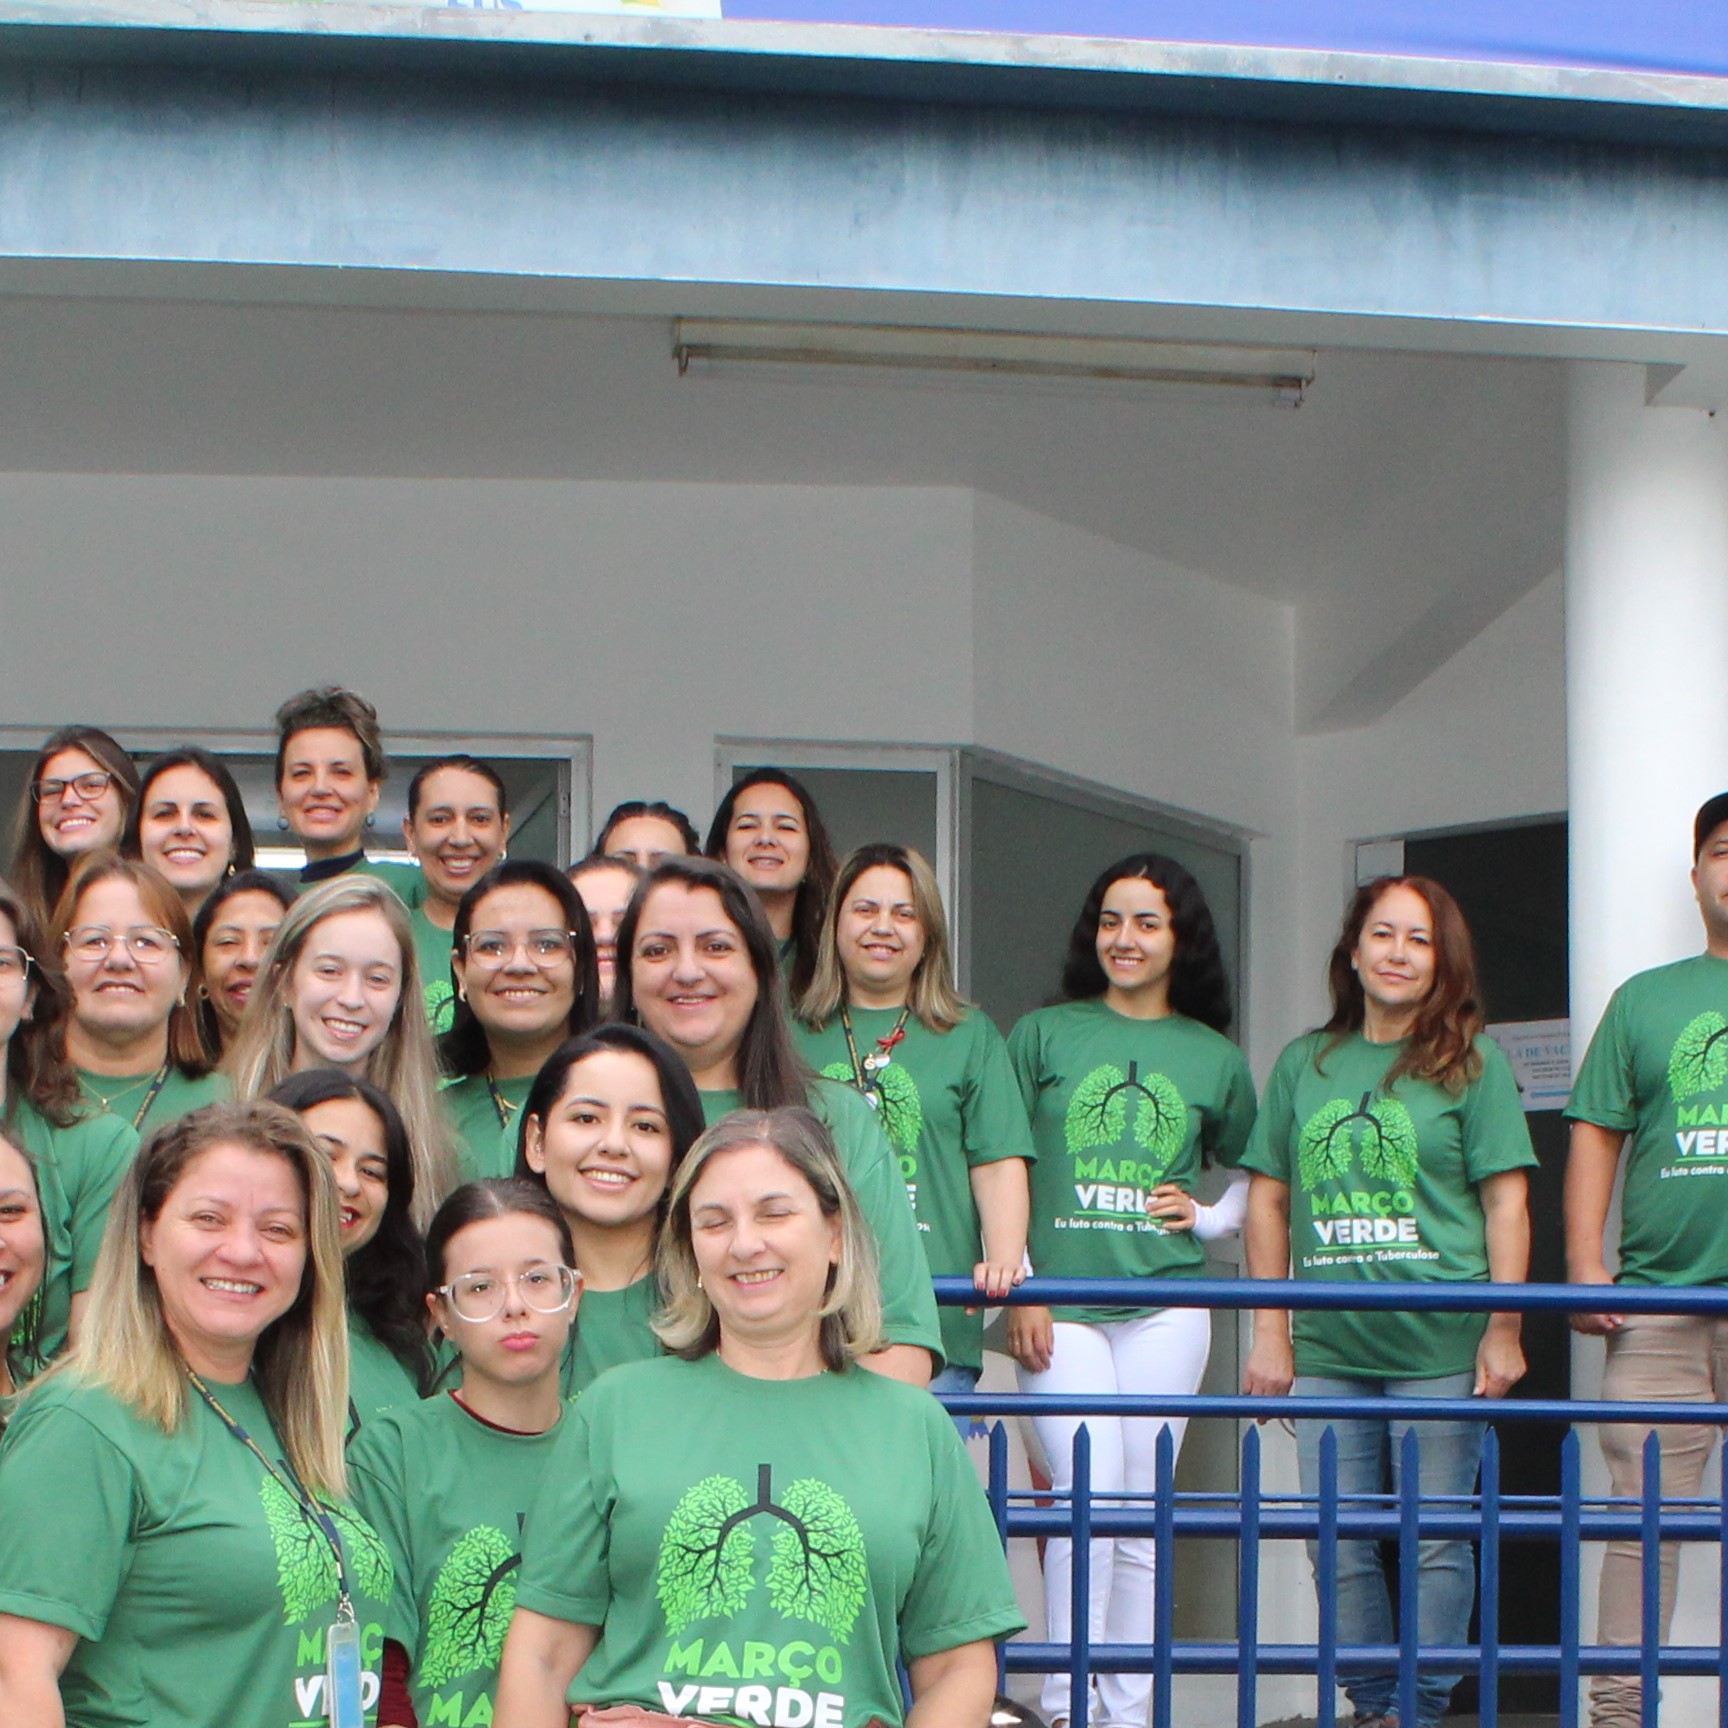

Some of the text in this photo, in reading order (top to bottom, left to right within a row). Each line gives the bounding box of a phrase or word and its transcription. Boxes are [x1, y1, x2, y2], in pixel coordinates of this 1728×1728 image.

[1690, 1165, 1724, 1176] contra
[1311, 1190, 1415, 1218] MARÇO
[1054, 1218, 1067, 1229] Eu
[1069, 1217, 1090, 1229] luto
[1092, 1219, 1125, 1232] contra
[1126, 1223, 1134, 1232] a
[1313, 1217, 1419, 1245] VERDE
[1313, 1255, 1333, 1266] luto
[1375, 1249, 1440, 1262] Tuberculose
[663, 1638, 842, 1688] MARÇO
